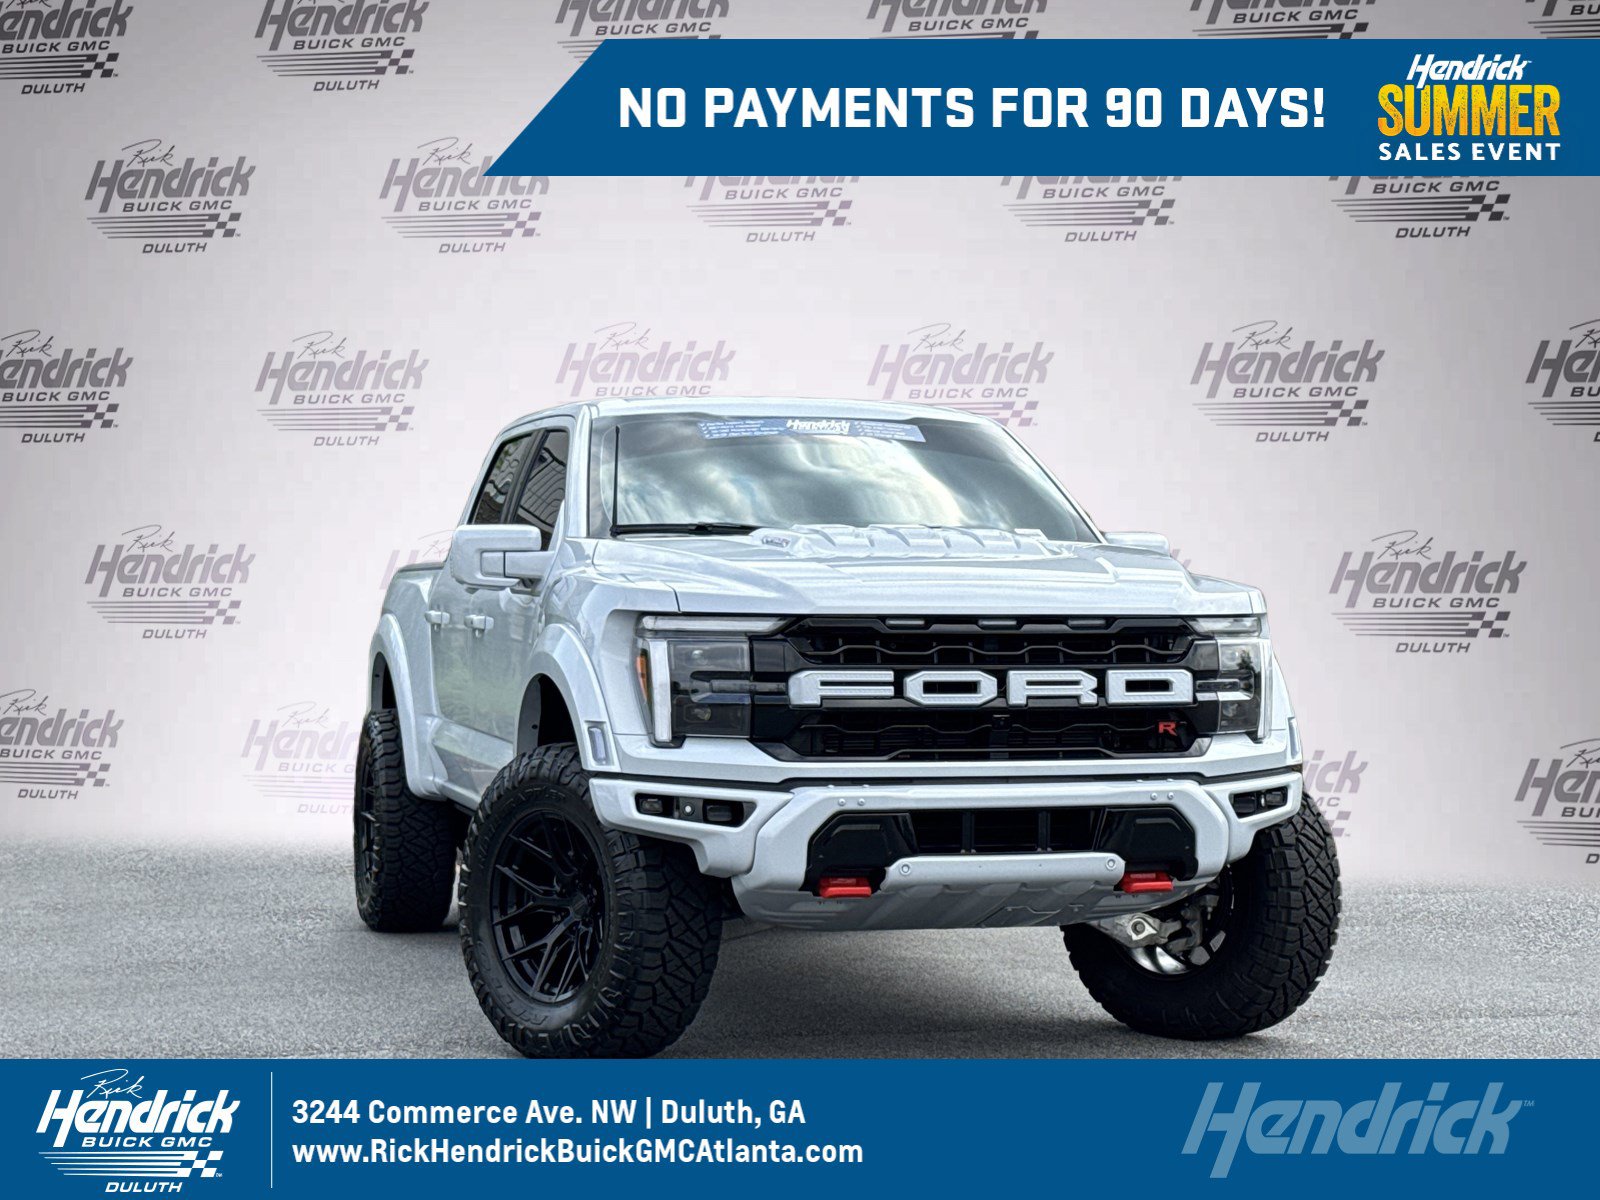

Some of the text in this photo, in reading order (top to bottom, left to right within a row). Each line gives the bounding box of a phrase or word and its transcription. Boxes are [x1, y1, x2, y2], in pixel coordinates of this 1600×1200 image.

[0, 0, 133, 40] endrick
[1233, 10, 1302, 24] BUICK
[1309, 9, 1358, 21] GMC
[255, 0, 429, 51] Hendrick
[595, 22, 712, 36] BUICK GMC
[909, 17, 1029, 32] BUICK GMC
[1, 40, 111, 54] BUICK GMC
[293, 36, 406, 51] BUICK GMC
[21, 82, 86, 95] DULUTH
[313, 79, 380, 92] DULUTH
[122, 139, 176, 168] Rick
[418, 137, 472, 166] Rick
[84, 156, 256, 213] Hendrick
[1372, 182, 1442, 194] BUICK
[1449, 180, 1500, 192] GMC
[725, 188, 789, 200] BUICK
[796, 187, 843, 198] GMC
[1042, 187, 1109, 199] BUICK
[1116, 185, 1165, 197] GMC
[122, 199, 233, 213] BUICK GMC
[418, 199, 532, 212] BUICK GMC
[745, 231, 816, 243] DULUTH
[1064, 230, 1137, 243] DULUTH
[1395, 226, 1471, 239] DULUTH
[142, 242, 208, 254] DULUTH
[438, 241, 506, 254] DULUTH
[594, 322, 650, 350] Rick
[907, 323, 965, 352] Rick
[1232, 320, 1294, 350] Rick
[293, 331, 347, 359] Rick
[0, 347, 133, 391] endrick
[555, 340, 736, 397] Hendrick
[867, 341, 1055, 399] Hendrick
[1190, 339, 1385, 399] Hendrick
[254, 349, 429, 404] Hendrick
[1, 390, 111, 403] BUICK GMC
[293, 392, 406, 405] BUICK GMC
[595, 385, 712, 398] BUICK GMC
[908, 386, 1029, 399] BUICK GMC
[1233, 385, 1359, 399] BUICK GMC
[21, 432, 86, 444] DULUTH
[313, 435, 380, 447] DULUTH
[1255, 431, 1330, 443] DULUTH
[122, 525, 176, 552] Rick
[1371, 530, 1432, 560] Rick
[84, 543, 256, 597] Hendrick
[1329, 550, 1528, 608] Hendrick
[122, 586, 233, 598] BUICK GMC
[1372, 597, 1500, 609] BUICK GMC
[142, 628, 208, 640] DULUTH
[1395, 642, 1471, 654] DULUTH
[787, 669, 1195, 708] FORD
[0, 709, 125, 749] endrick
[1158, 721, 1177, 737] R
[0, 748, 103, 761] BUICK GMC
[278, 762, 337, 774] BUICK
[17, 788, 79, 800] DULUTH
